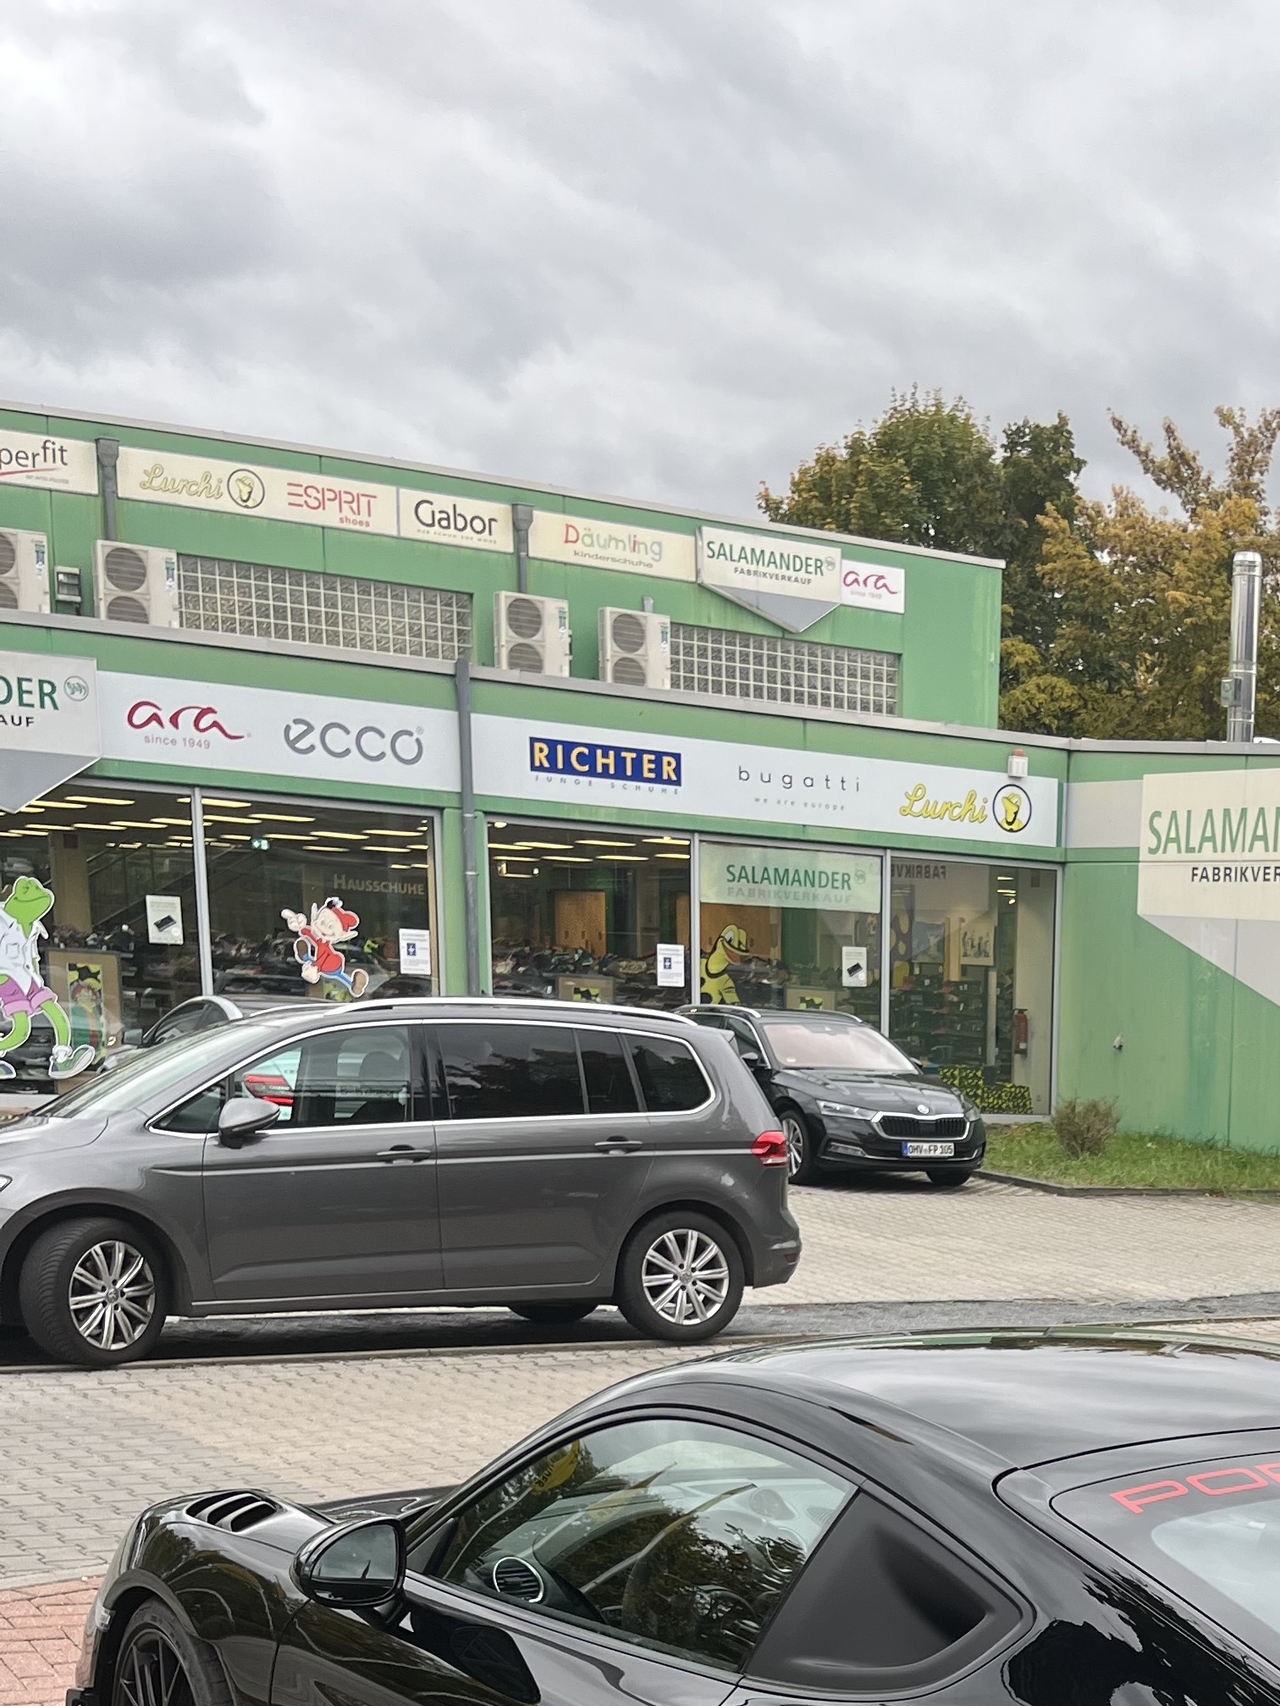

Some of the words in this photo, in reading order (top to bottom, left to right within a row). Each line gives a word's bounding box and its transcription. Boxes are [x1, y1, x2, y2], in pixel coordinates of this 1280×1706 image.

[139, 464, 223, 499] Lurchi
[286, 482, 377, 517] ESPRIT
[339, 516, 371, 527] shoes
[414, 499, 498, 536] Gabor
[564, 523, 662, 562] Däumling
[707, 540, 824, 576] SALAMANDER
[573, 550, 654, 569] kinderschuhe
[734, 567, 813, 585] FABRIKVERKAUF
[843, 570, 899, 594] ara
[127, 700, 245, 740] ara
[144, 734, 177, 746] since
[182, 738, 211, 749] 1949
[284, 718, 424, 765] ecco
[533, 742, 678, 781] RICHTER
[535, 776, 593, 787] JUNGE
[610, 782, 679, 795] SCHUHE
[738, 765, 860, 792] bugatti
[899, 783, 988, 824] Lurchi
[726, 864, 852, 891] SALAMANDER
[727, 886, 851, 904] FABRIKVERKAUF
